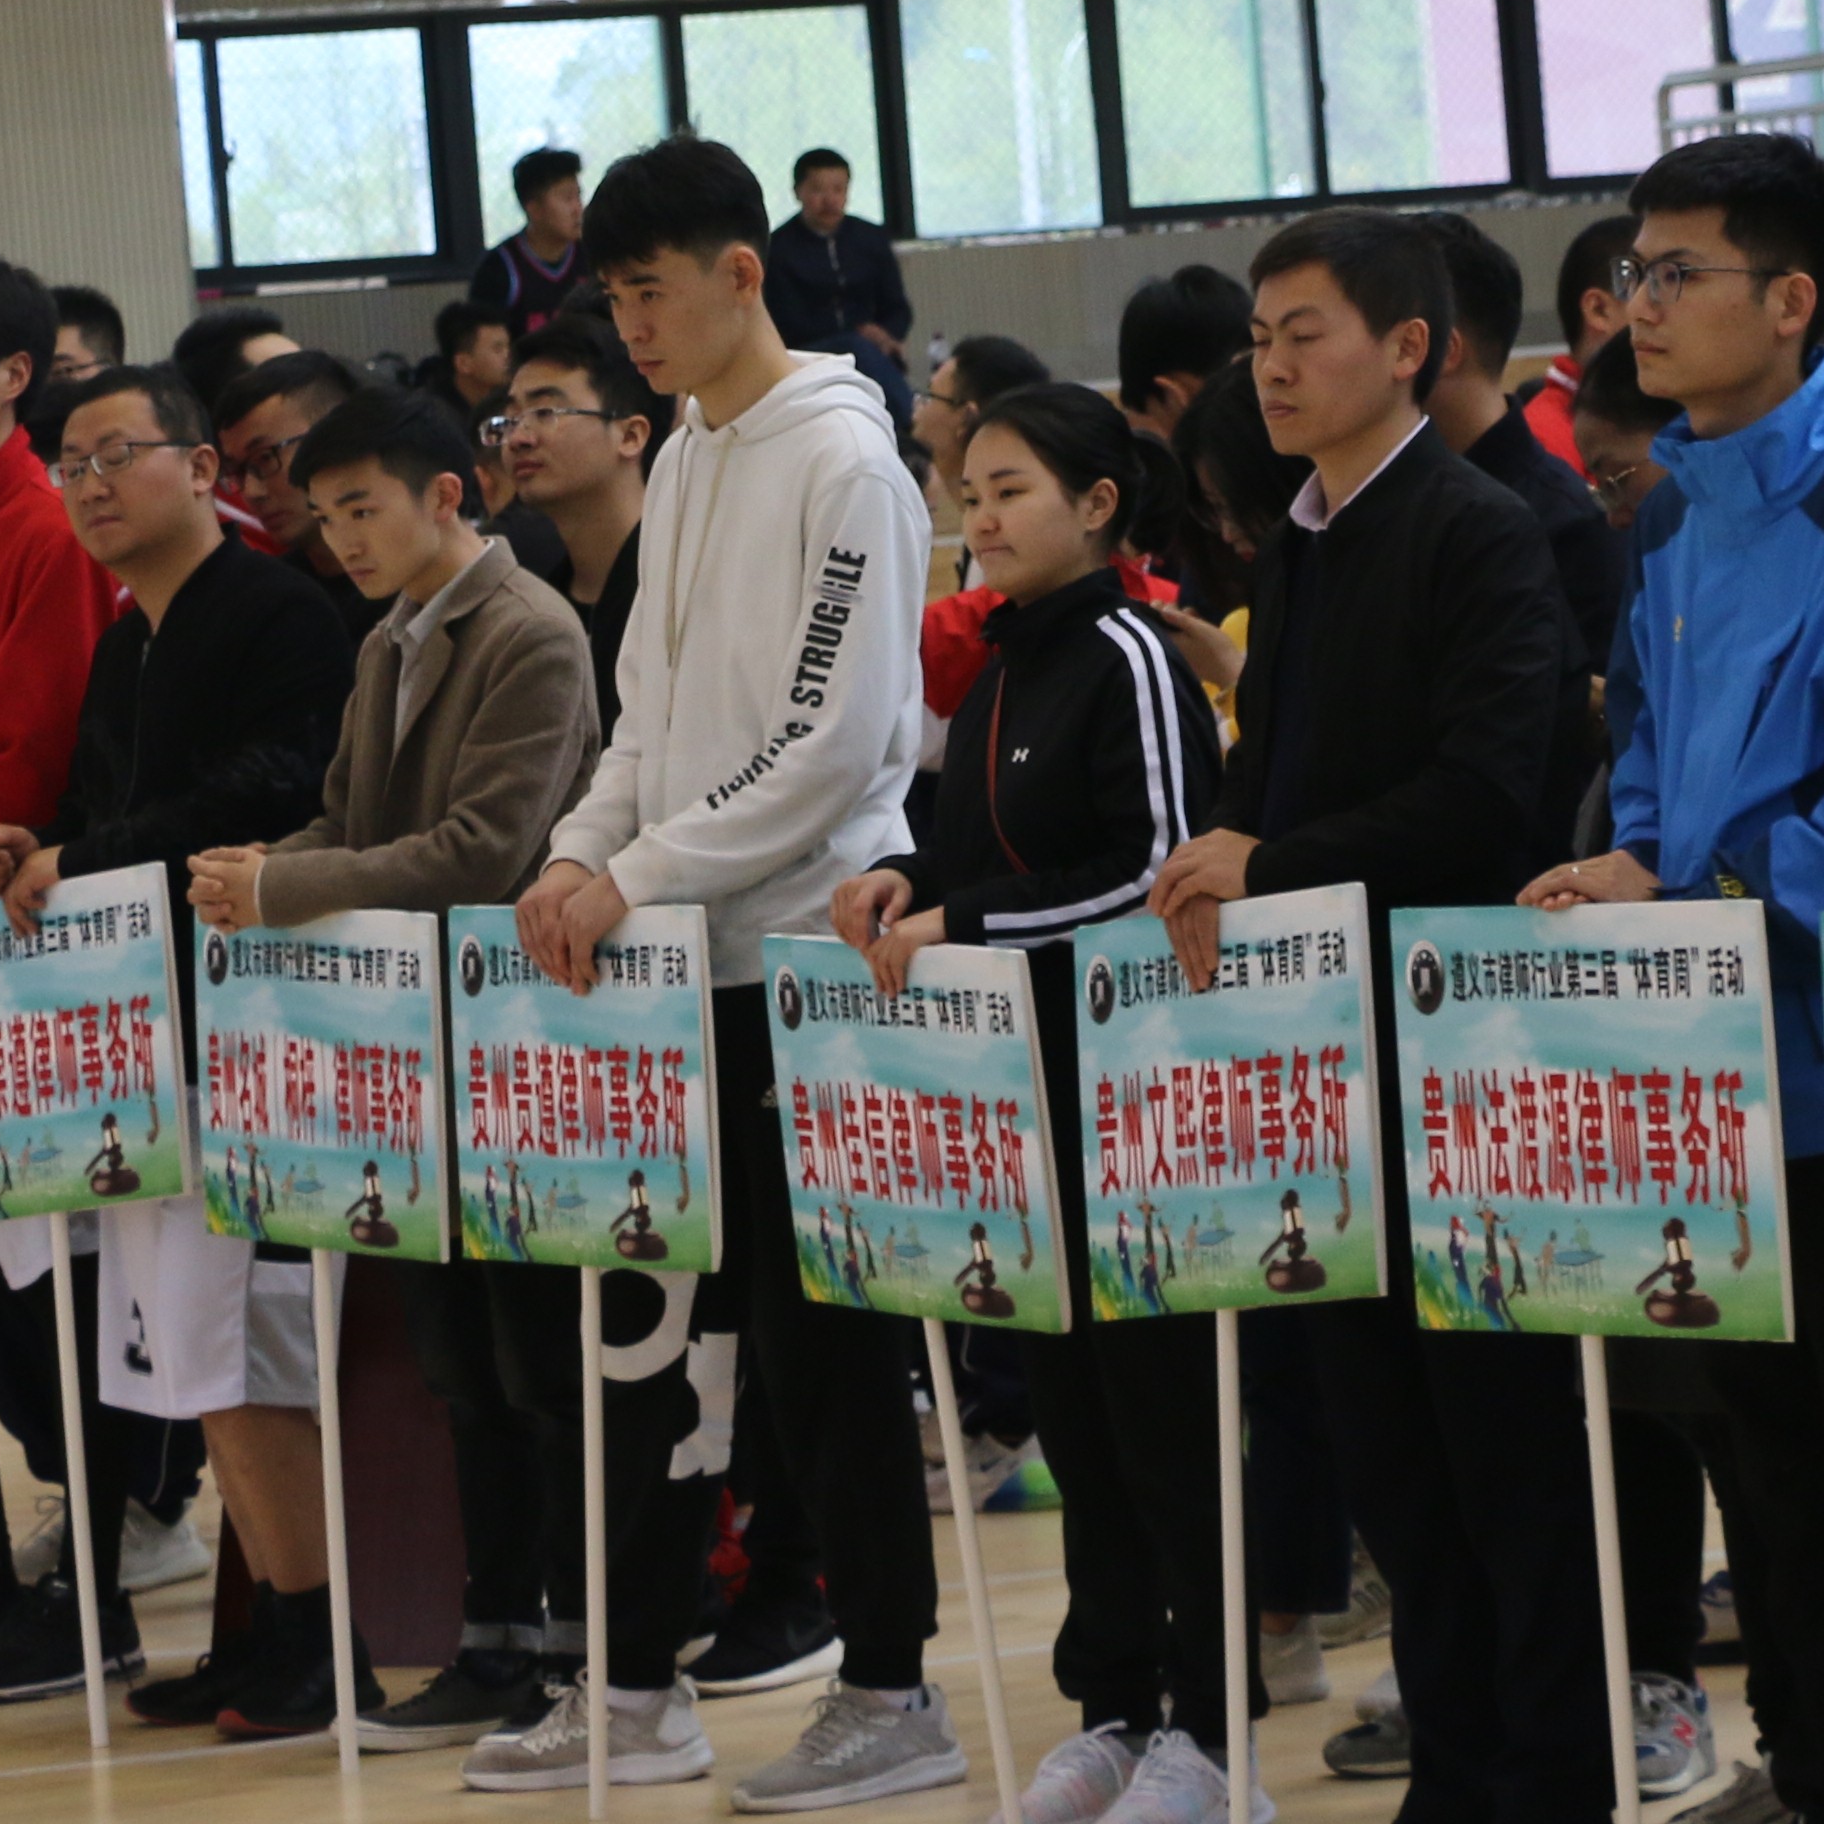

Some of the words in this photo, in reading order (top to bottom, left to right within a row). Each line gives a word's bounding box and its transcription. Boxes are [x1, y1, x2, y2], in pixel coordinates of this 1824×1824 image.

[791, 1075, 1031, 1214] 贵州佳信律师事务所
[1096, 1043, 1351, 1198] 贵州文熙律师事务所
[1422, 1066, 1752, 1206] 贵州法渡源律师事务所
